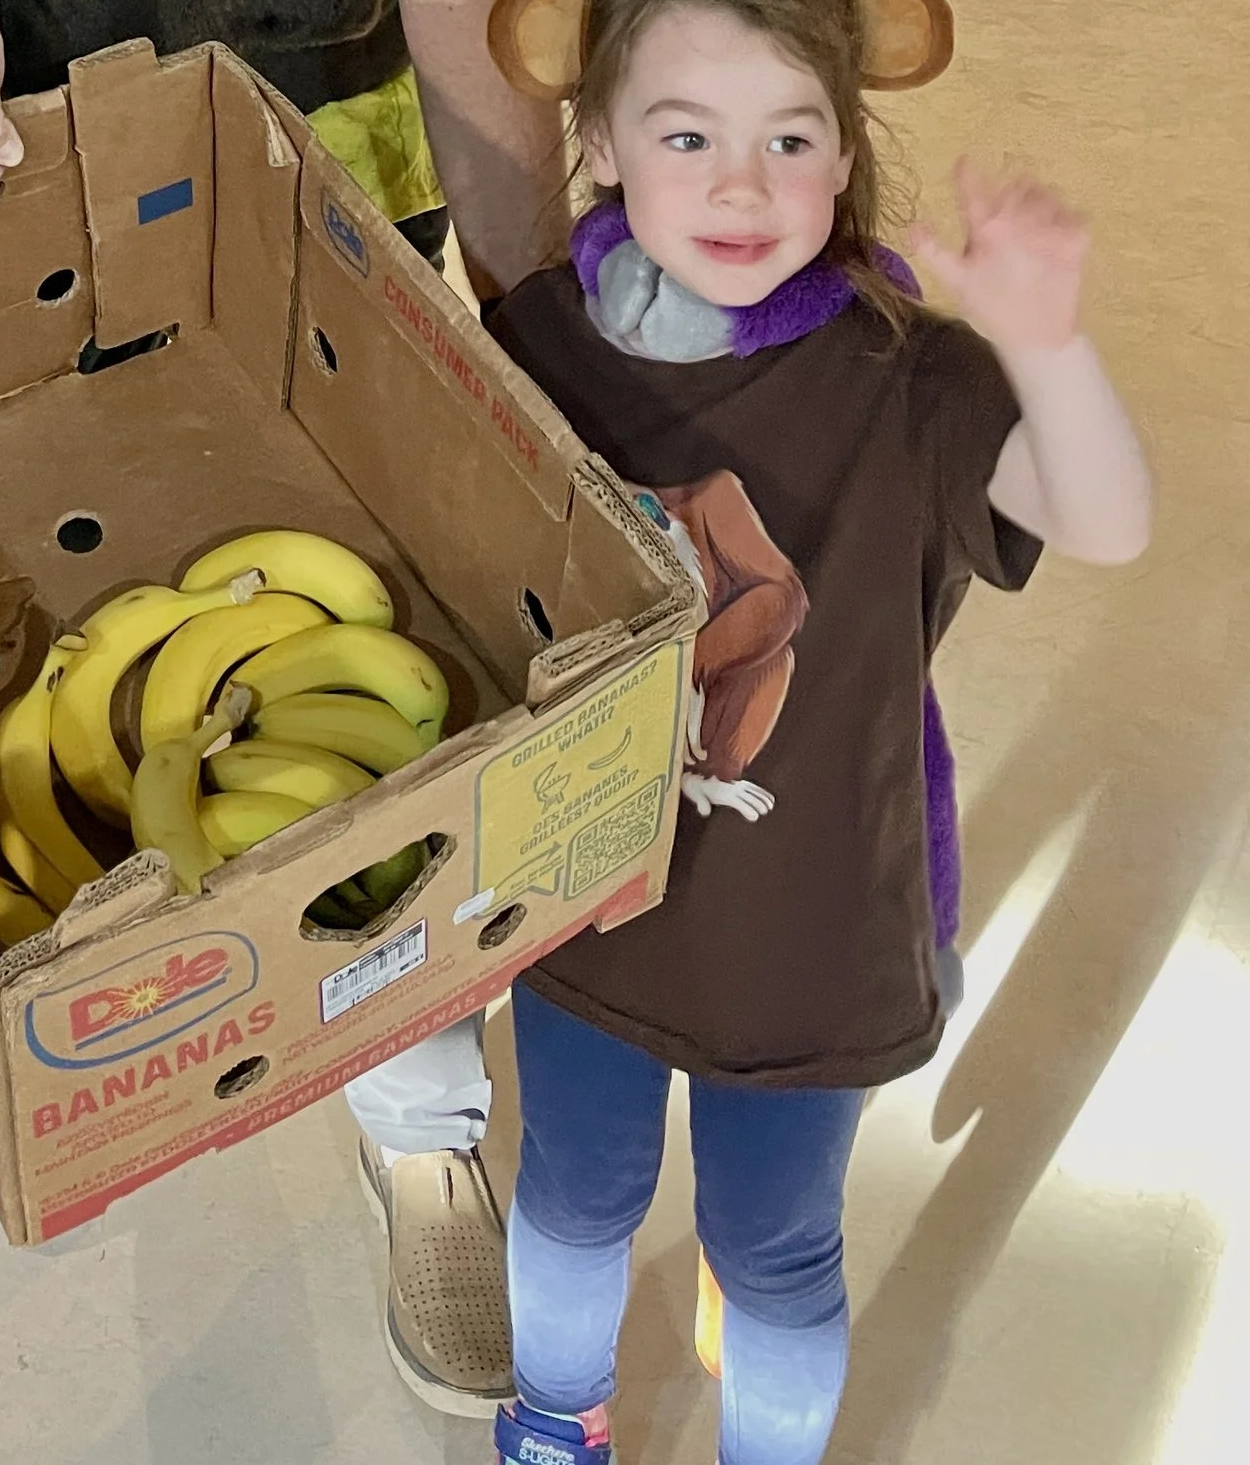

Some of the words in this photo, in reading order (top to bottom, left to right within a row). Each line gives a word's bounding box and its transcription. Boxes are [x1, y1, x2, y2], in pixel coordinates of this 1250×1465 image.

[383, 275, 486, 403] CONSUMER
[491, 399, 538, 471] PACK
[512, 720, 573, 767] GRILLED
[578, 659, 657, 726] BANANAS?
[533, 810, 560, 834] DES
[564, 764, 628, 815] BANANES
[69, 948, 229, 1041] Dole
[32, 1000, 277, 1138] BANANAS
[248, 1061, 361, 1130] PREMIUM
[369, 991, 478, 1067] BANANAS
